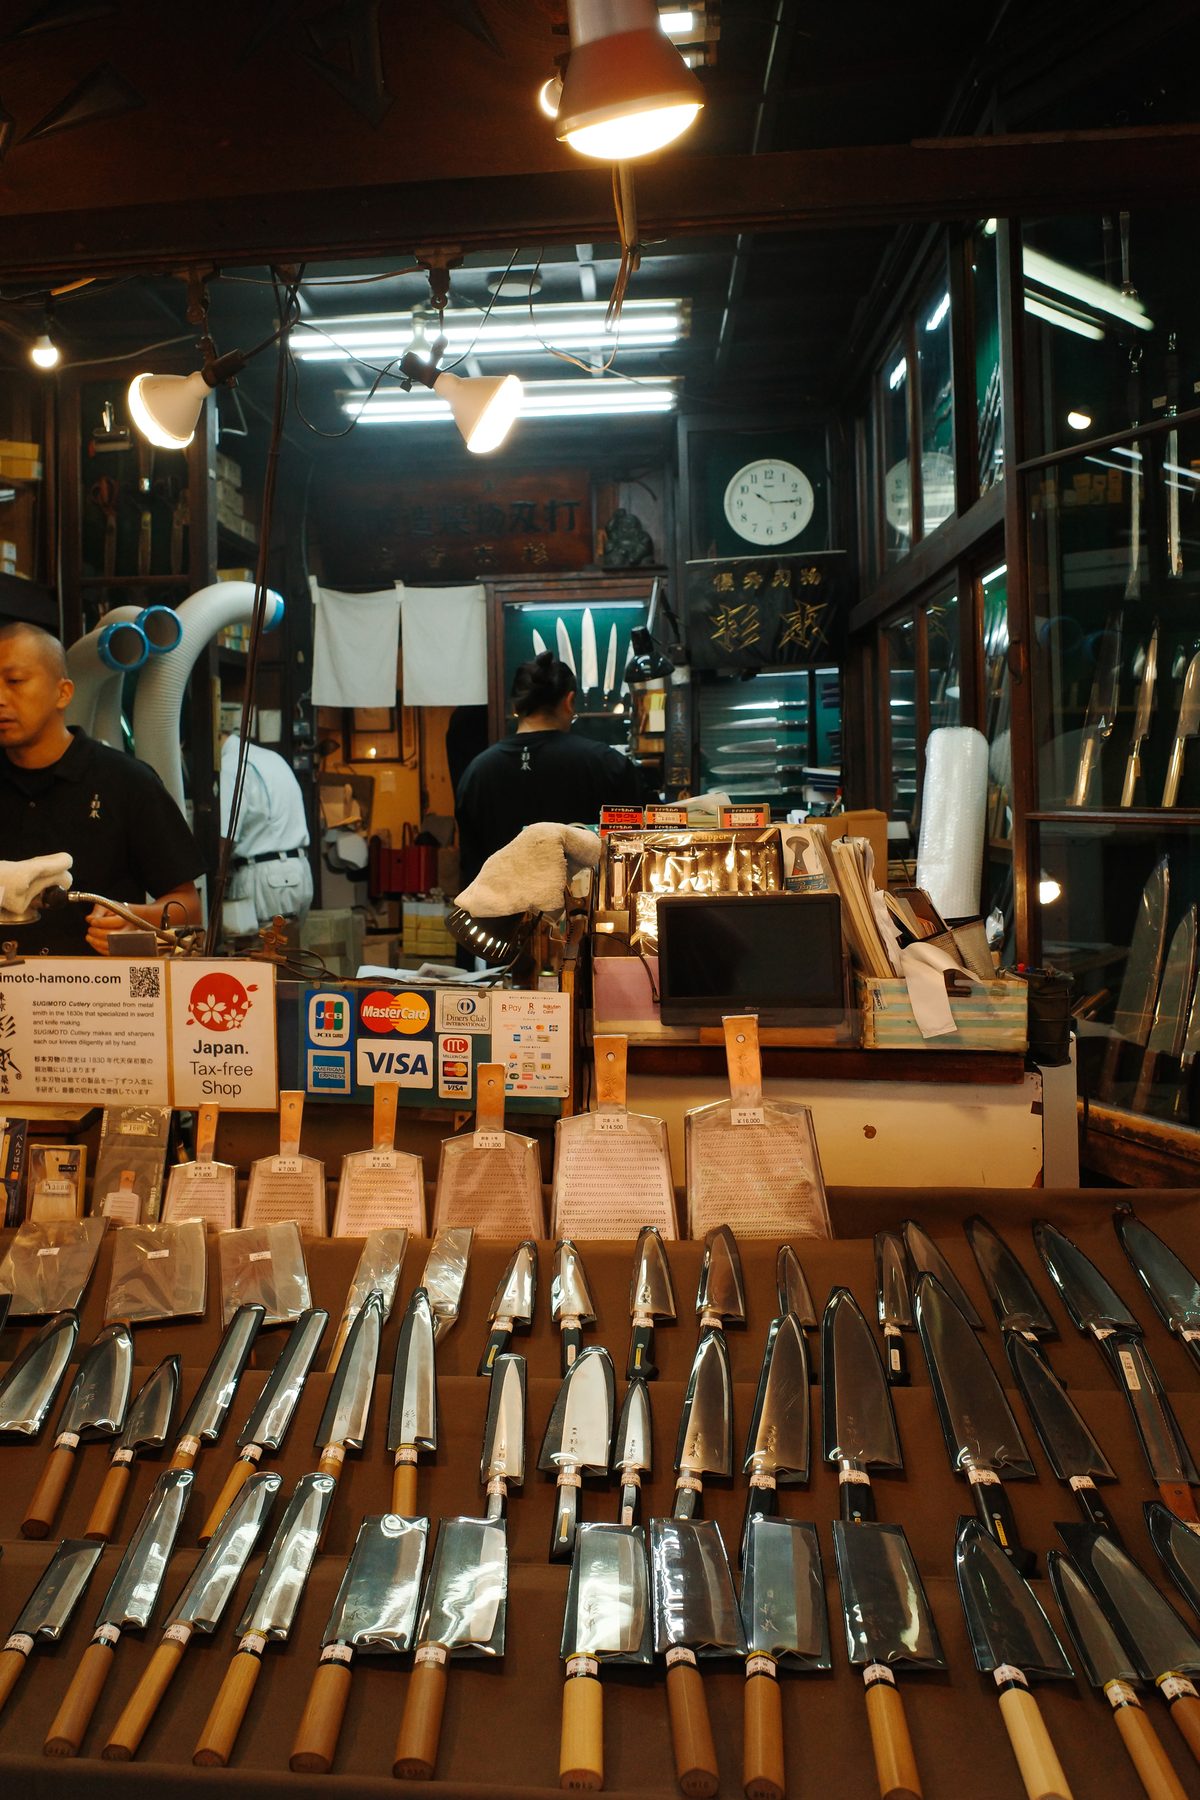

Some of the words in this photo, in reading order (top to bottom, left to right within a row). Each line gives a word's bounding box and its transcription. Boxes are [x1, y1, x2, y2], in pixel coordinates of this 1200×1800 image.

[751, 474, 757, 484] 11
[765, 469, 774, 480] 12
[782, 472, 786, 482] 1
[741, 485, 749, 494] 10
[792, 483, 798, 493] 2
[736, 499, 743, 509] 9
[741, 513, 748, 522] 8
[790, 511, 797, 520] 4
[752, 523, 758, 533] 7
[766, 526, 773, 536] 6
[782, 522, 788, 532] 5
[362, 1005, 428, 1021] MasterCard
[508, 1004, 522, 1012] Pay
[470, 1014, 487, 1022] Club
[192, 1040, 249, 1057] Japan.
[361, 1051, 429, 1076] VISA
[189, 1061, 254, 1077] Tax-free
[201, 1080, 242, 1098] Shop
